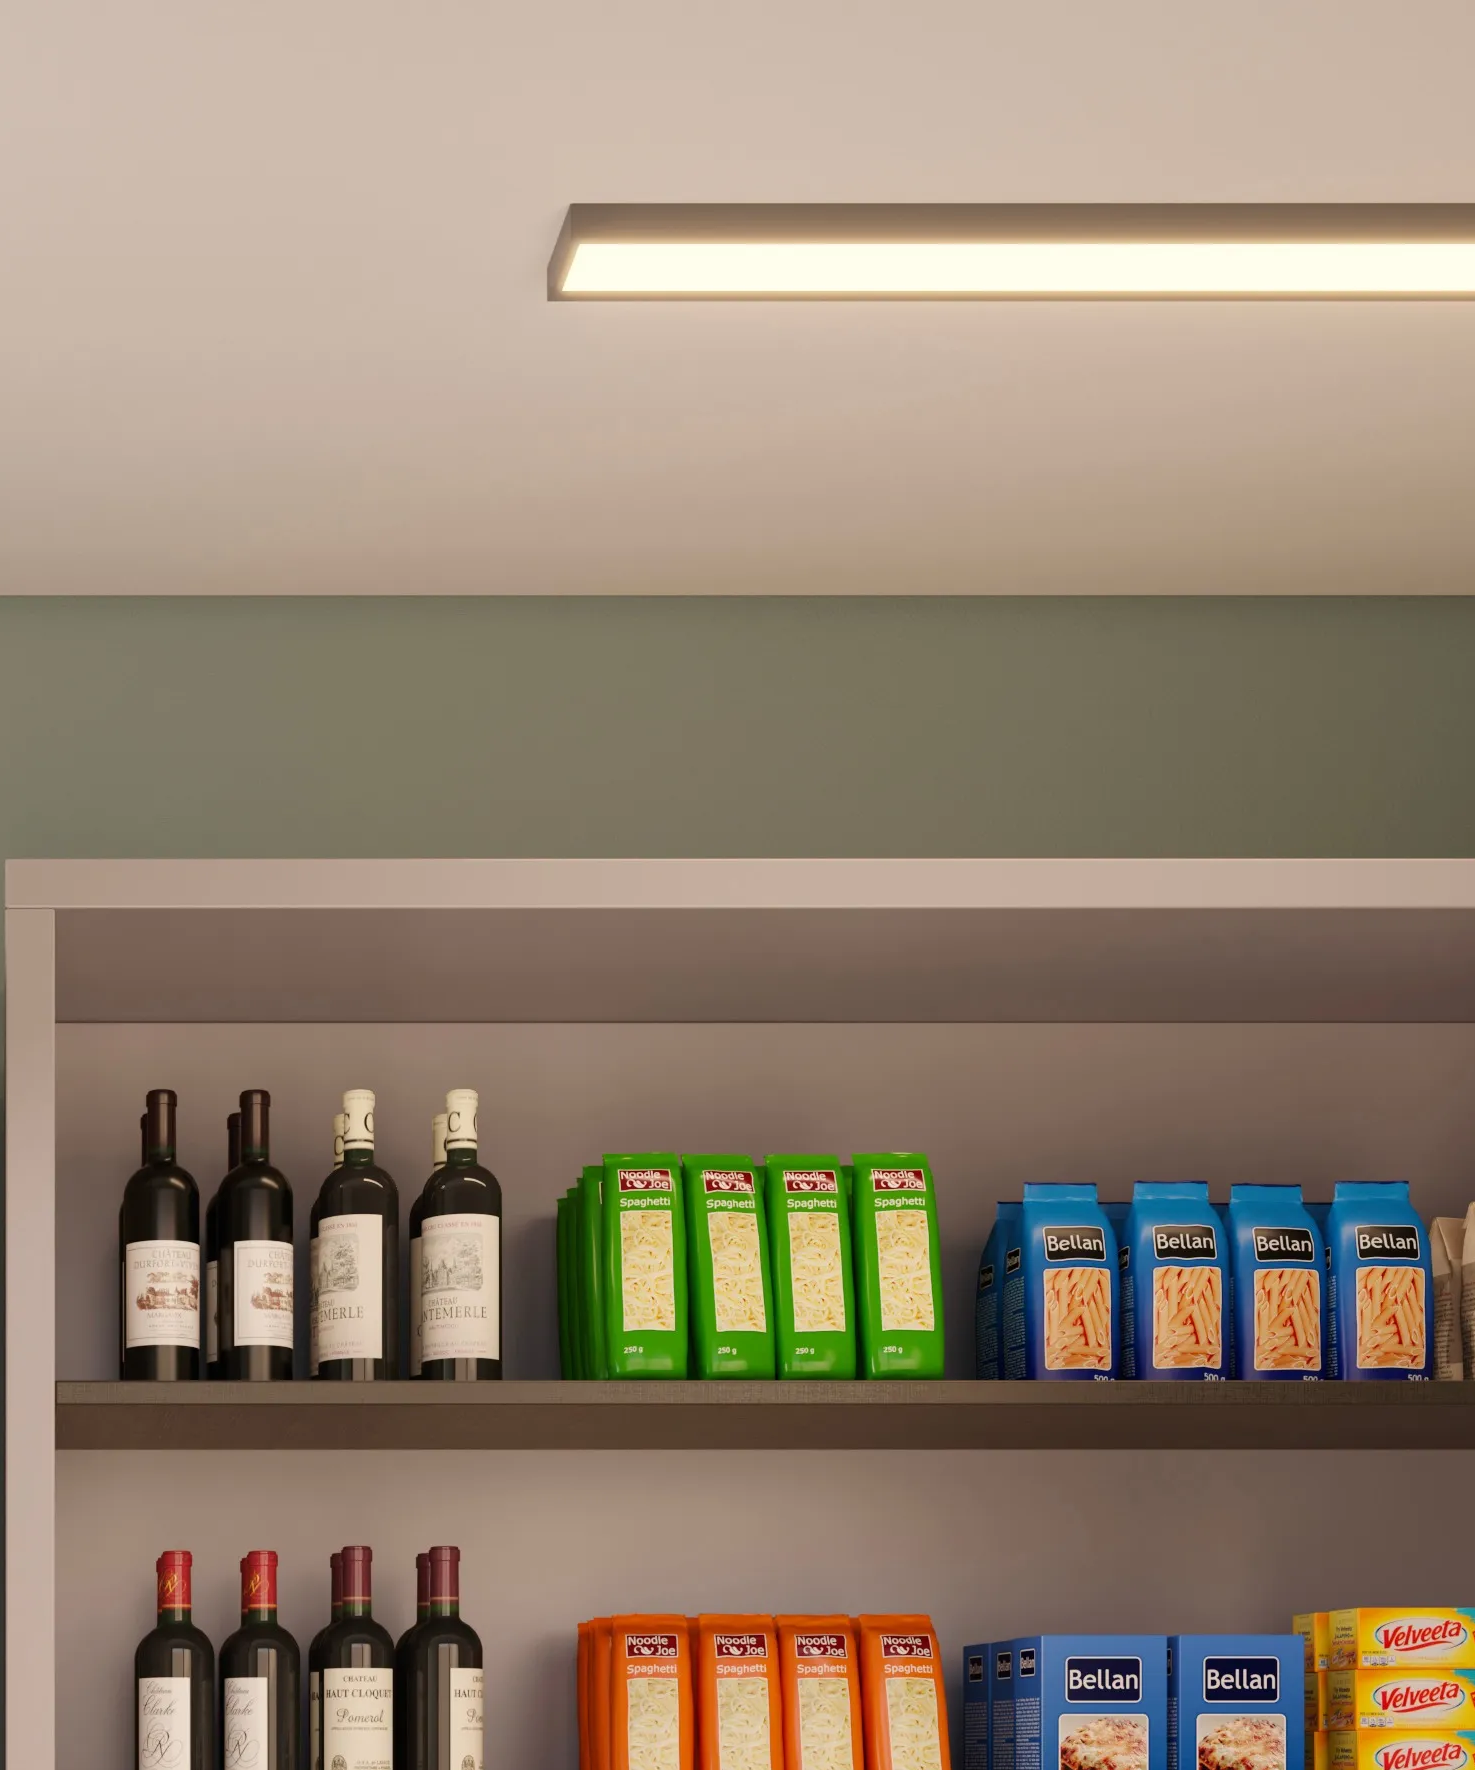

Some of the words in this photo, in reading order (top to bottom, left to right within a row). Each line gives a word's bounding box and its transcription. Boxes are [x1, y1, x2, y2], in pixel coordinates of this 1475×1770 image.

[621, 1171, 660, 1180] Noodle
[649, 1179, 668, 1190] Joe
[619, 1196, 671, 1209] Spaghetti
[1048, 1235, 1103, 1253] Bellan
[1383, 1619, 1462, 1649] Velveeta
[797, 1664, 847, 1675] Spaghetti
[326, 1689, 349, 1698] HAUT
[351, 1689, 392, 1699] CLOQUET
[336, 1709, 383, 1724] Pomerol
